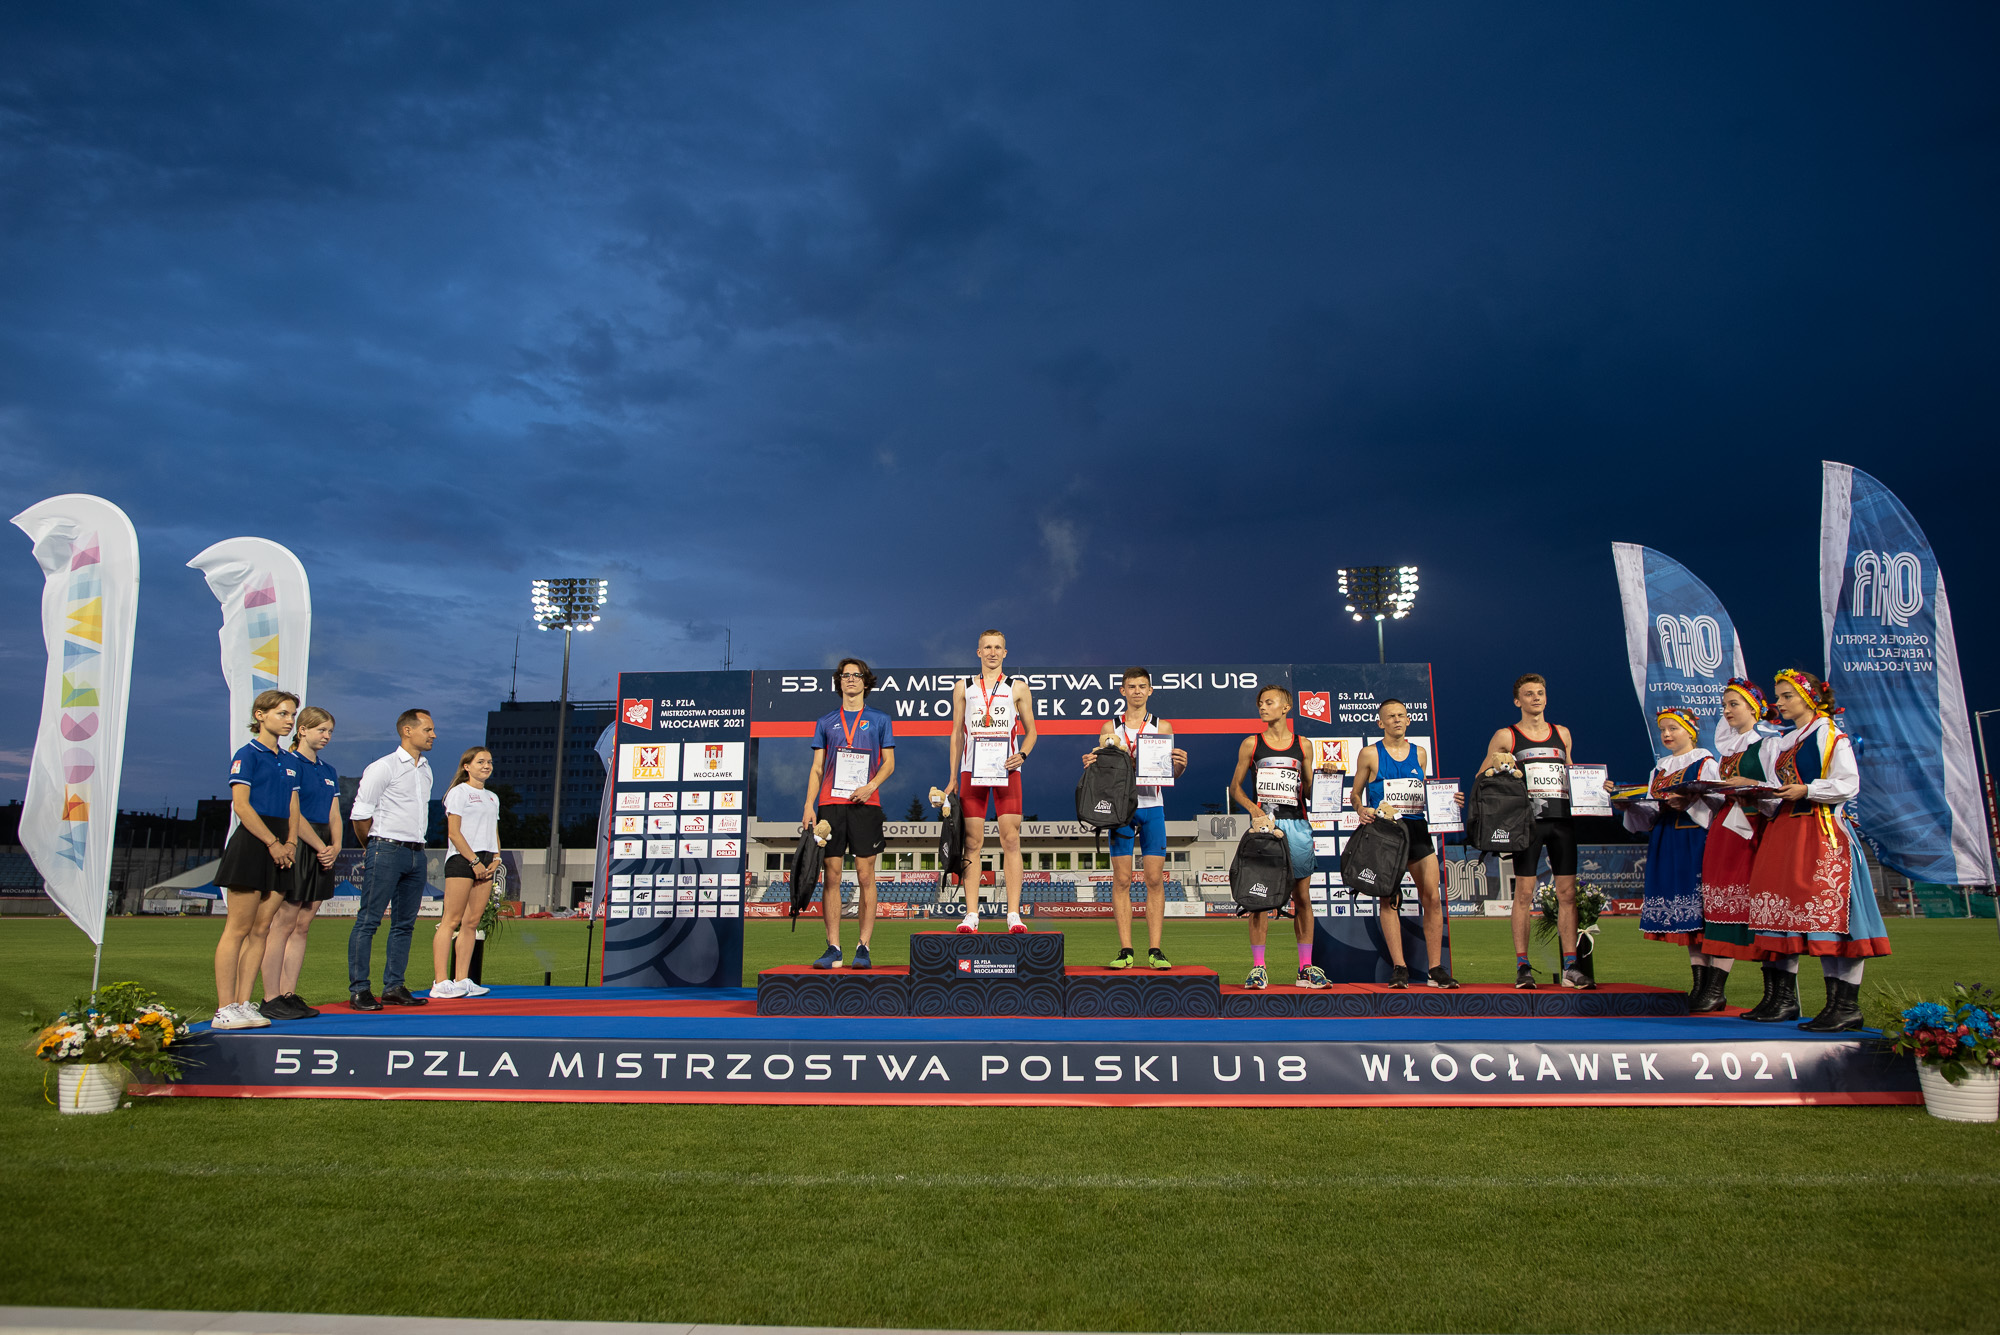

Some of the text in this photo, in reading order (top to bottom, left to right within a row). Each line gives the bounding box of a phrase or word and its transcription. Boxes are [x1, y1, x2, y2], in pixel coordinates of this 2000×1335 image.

[782, 676, 823, 692] 53.
[1109, 673, 1203, 690] PLSKI
[1211, 673, 1258, 689] U18
[1354, 692, 1375, 700] PZLA
[676, 699, 696, 707] PZLA
[1339, 703, 1381, 711] MISTRZOSTW
[1414, 702, 1428, 710] U18
[896, 698, 1126, 717] WŁOEK 202
[994, 706, 1006, 714] 59
[660, 709, 707, 717] MISTRZOSTWA
[1339, 713, 1380, 722] WŁOCŁA
[660, 719, 745, 729] WŁOCŁAWEK 2021
[972, 720, 1009, 728] MAWSKI
[842, 752, 865, 760] DYPLOM
[634, 768, 663, 778] PZLA
[1280, 770, 1297, 781] 592
[1258, 781, 1296, 793] ZIELIŃSK
[882, 825, 927, 835] PORTU
[1029, 825, 1050, 835] WE
[636, 892, 650, 900] 4F
[1065, 906, 1096, 914] ZWIĄZEK
[274, 1048, 1799, 1083] 53. PZLA MISTRZOSTWA POLSKI U18 WŁOCŁAWEK 2021
